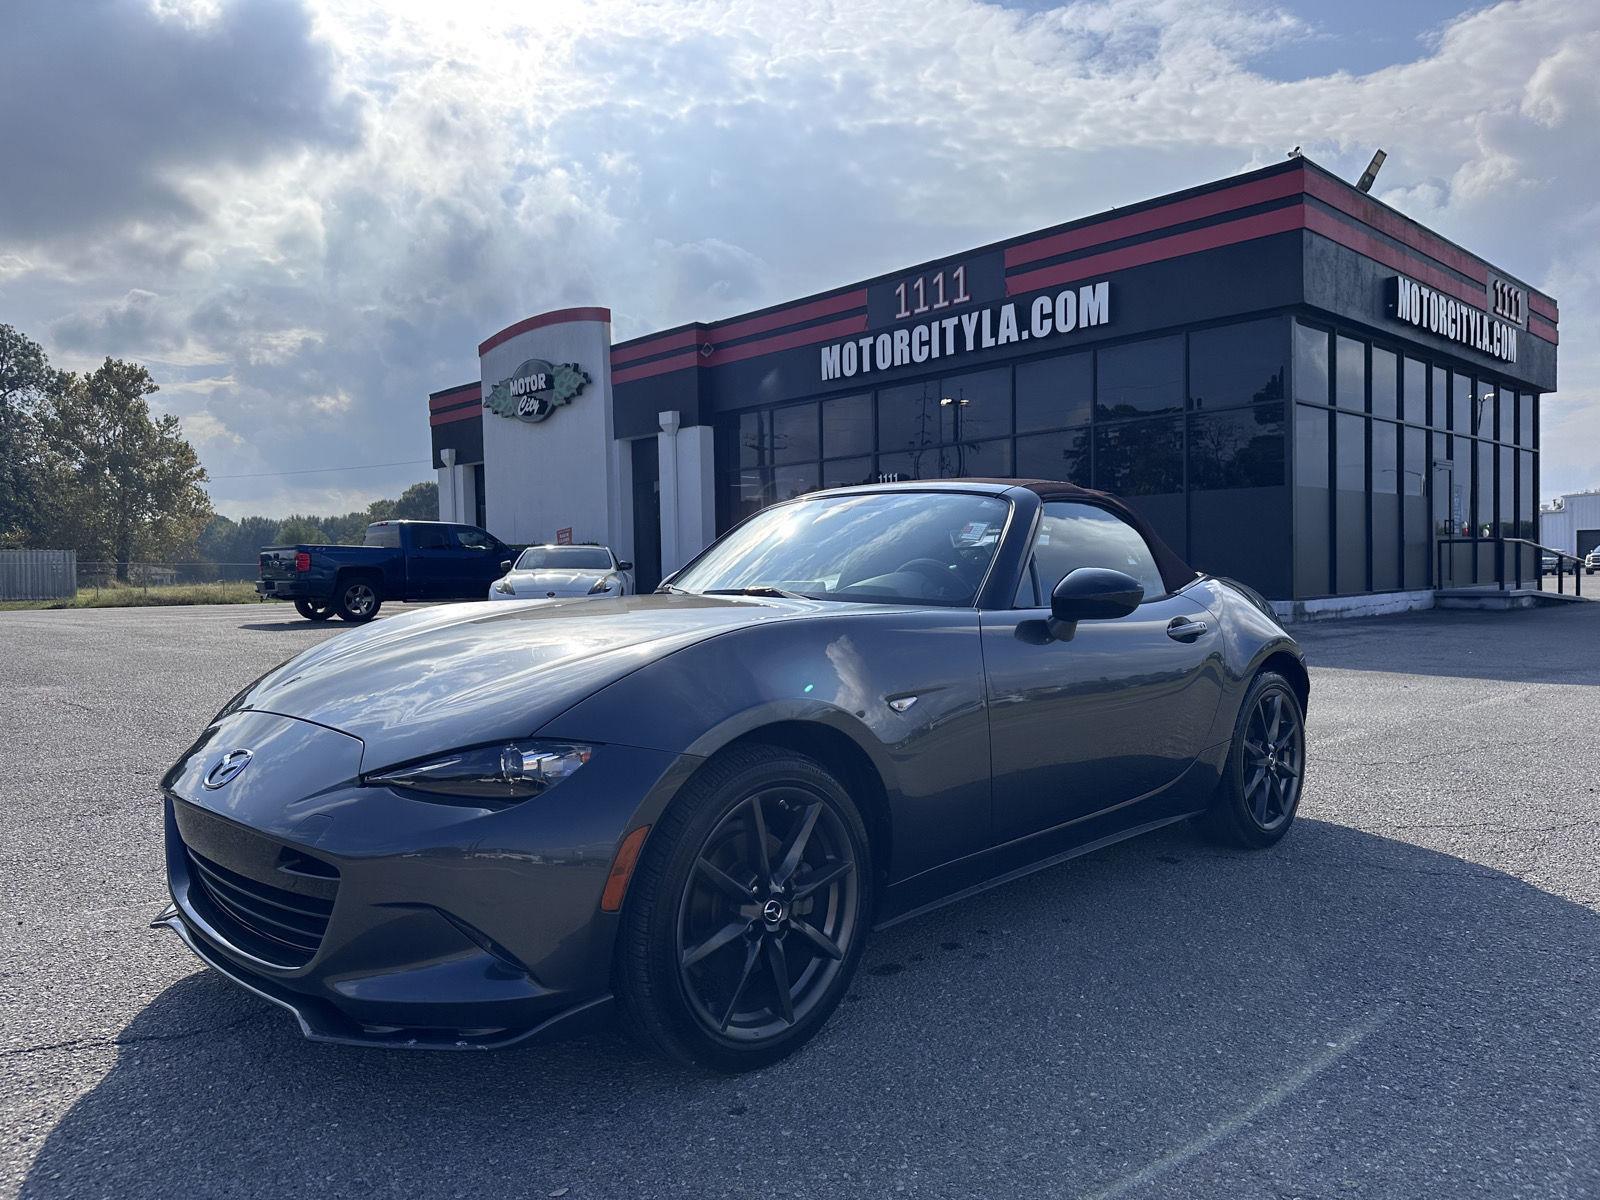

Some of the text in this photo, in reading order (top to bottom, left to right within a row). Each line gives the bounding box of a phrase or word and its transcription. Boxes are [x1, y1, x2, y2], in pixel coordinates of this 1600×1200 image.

[895, 264, 971, 319] 1111
[1494, 279, 1522, 324] 1111
[821, 281, 1110, 381] MOTORCITYLA.COM
[1397, 275, 1517, 363] MOTORCITYLA.COM
[509, 373, 546, 396] MOTOR
[518, 395, 540, 416] City
